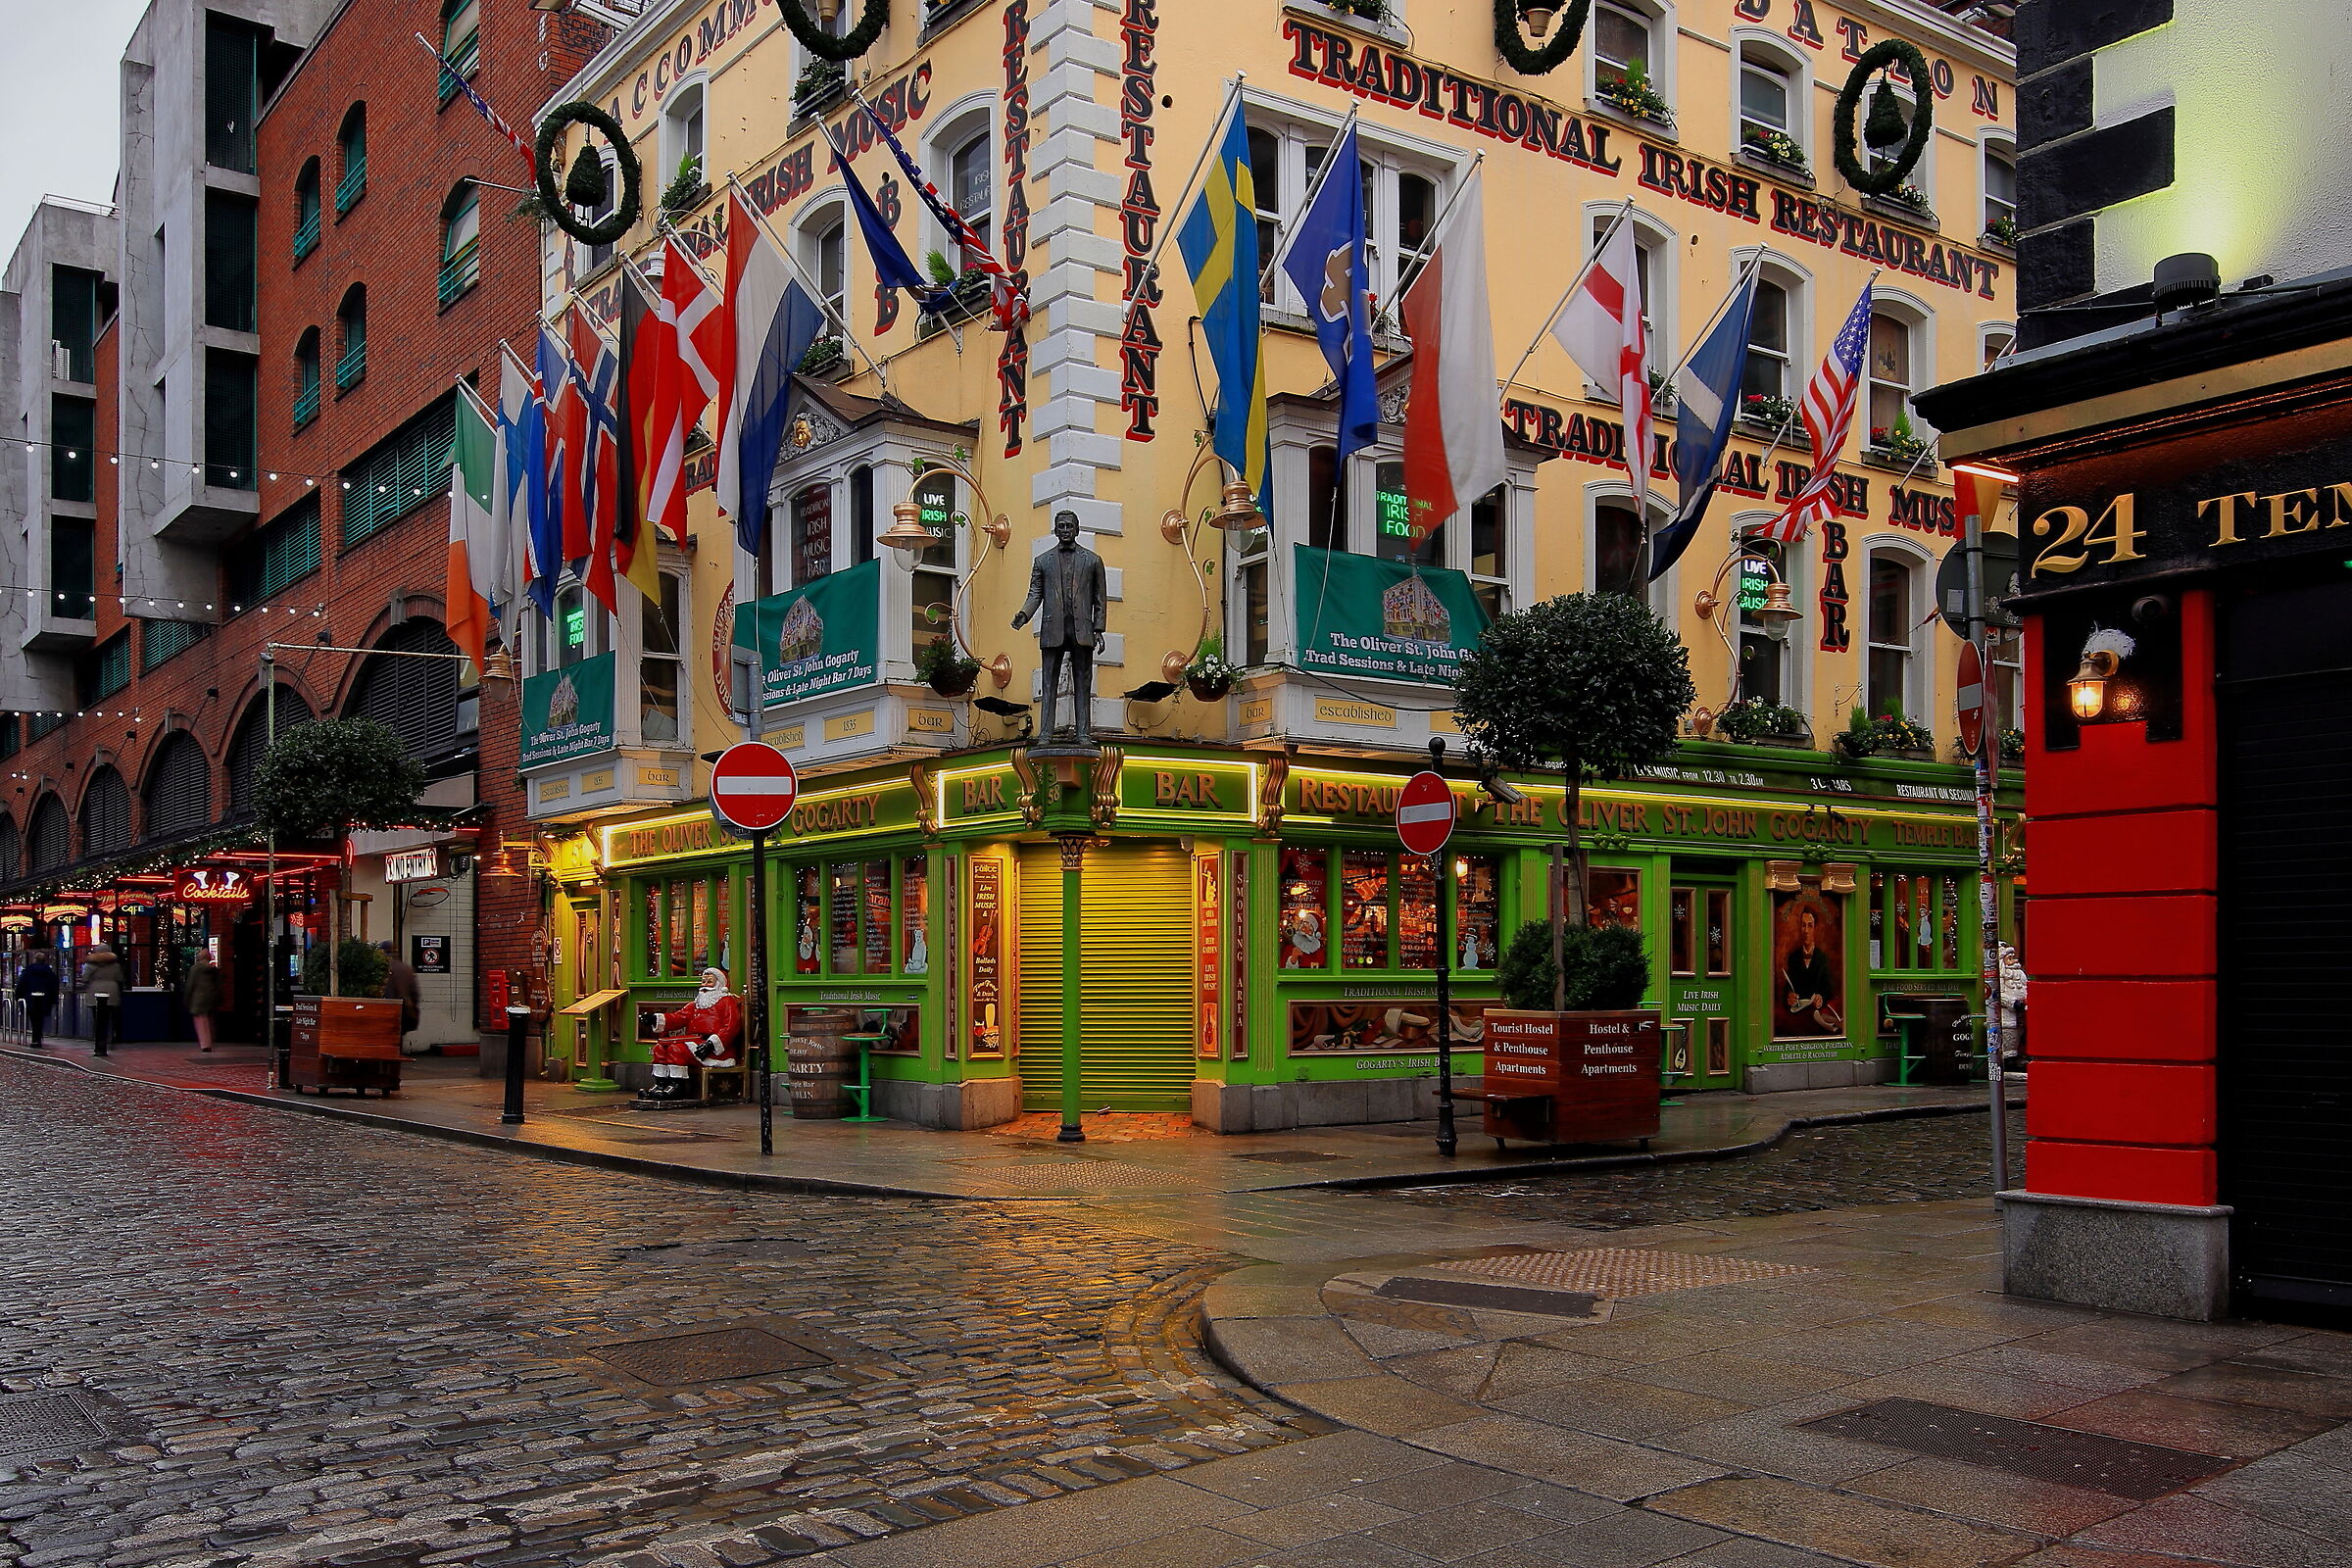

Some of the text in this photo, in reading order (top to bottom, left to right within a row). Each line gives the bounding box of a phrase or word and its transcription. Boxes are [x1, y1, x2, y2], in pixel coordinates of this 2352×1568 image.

[605, 0, 771, 145] ACCOMM
[827, 59, 933, 174] MUSIC
[1283, 19, 2000, 301] TRADITIONAL IRISH RESTAURANT
[1000, 1, 1032, 459] RESTAUANT
[1119, 0, 1163, 444] RESTAURANT
[923, 493, 945, 507] LIVE
[1775, 460, 1955, 539] IRSH MUS
[921, 508, 947, 523] IRISH
[808, 515, 827, 537] IRISH
[2032, 493, 2147, 579] 24
[804, 536, 830, 558] MUSIC
[808, 560, 825, 578] BAR
[1744, 559, 1767, 574] LIVE
[1741, 577, 1769, 591] IRISH
[1820, 520, 1850, 653] BAR
[1330, 632, 1357, 650] The
[1359, 637, 1402, 654] Oliver
[1404, 642, 1424, 657] St.
[1426, 645, 1456, 661] John
[767, 667, 792, 685] Oliver
[793, 663, 804, 677] St.
[804, 660, 824, 677] John
[825, 649, 859, 671] Gogarty
[1306, 649, 1466, 680] Trad Sessions & Late Nig
[762, 685, 785, 702] ssions
[792, 679, 808, 696] Late
[808, 674, 832, 694] Night
[832, 672, 847, 685] Bar
[847, 669, 854, 681] 7
[854, 664, 872, 682] Days
[1319, 706, 1392, 722] established
[538, 732, 556, 744] Oliver
[579, 721, 601, 735] Gogarty
[532, 749, 552, 760] Sessions
[557, 745, 568, 755] Late
[584, 738, 593, 747] Bar
[597, 735, 610, 745] Days
[1654, 765, 1681, 781] MUSIC
[1682, 771, 1698, 781] FROM
[1702, 769, 1725, 783] 12.30
[963, 776, 1008, 814] BAR
[1154, 771, 1223, 808] BAR
[1896, 784, 1975, 802] RESTAURANT ON SECOND
[791, 794, 881, 836] GOGARTY
[1299, 777, 1467, 821] RESTAUT
[1557, 800, 1650, 833] OLIVER
[1663, 804, 1696, 837] ST.
[1702, 807, 1758, 839] JOHN
[1770, 811, 1873, 846] GOGARTY
[1892, 820, 1949, 847] TEMPLE
[630, 830, 657, 858] THE
[662, 821, 712, 854] OLIVER
[183, 883, 249, 898] Cocktails
[1204, 963, 1215, 972] LIVE
[863, 991, 881, 1001] Music
[1344, 987, 1429, 997] TRADITIONAL IRISH
[1684, 990, 1720, 1001] LIVE IRISH
[1896, 983, 1912, 992] FOOD
[1677, 1003, 1722, 1012] MUSIC DAILY
[1492, 1022, 1553, 1035] Tourist Hostel
[1590, 1023, 1630, 1035] Hostel &
[1494, 1042, 1548, 1055] & Penthouse
[1584, 1044, 1634, 1055] Penthouse
[789, 1062, 825, 1074] GARTY
[1356, 1059, 1404, 1070] GOGARTY'S
[1407, 1057, 1431, 1068] IRISH
[1494, 1060, 1546, 1075] Apartments
[1581, 1062, 1638, 1075] Apartments
